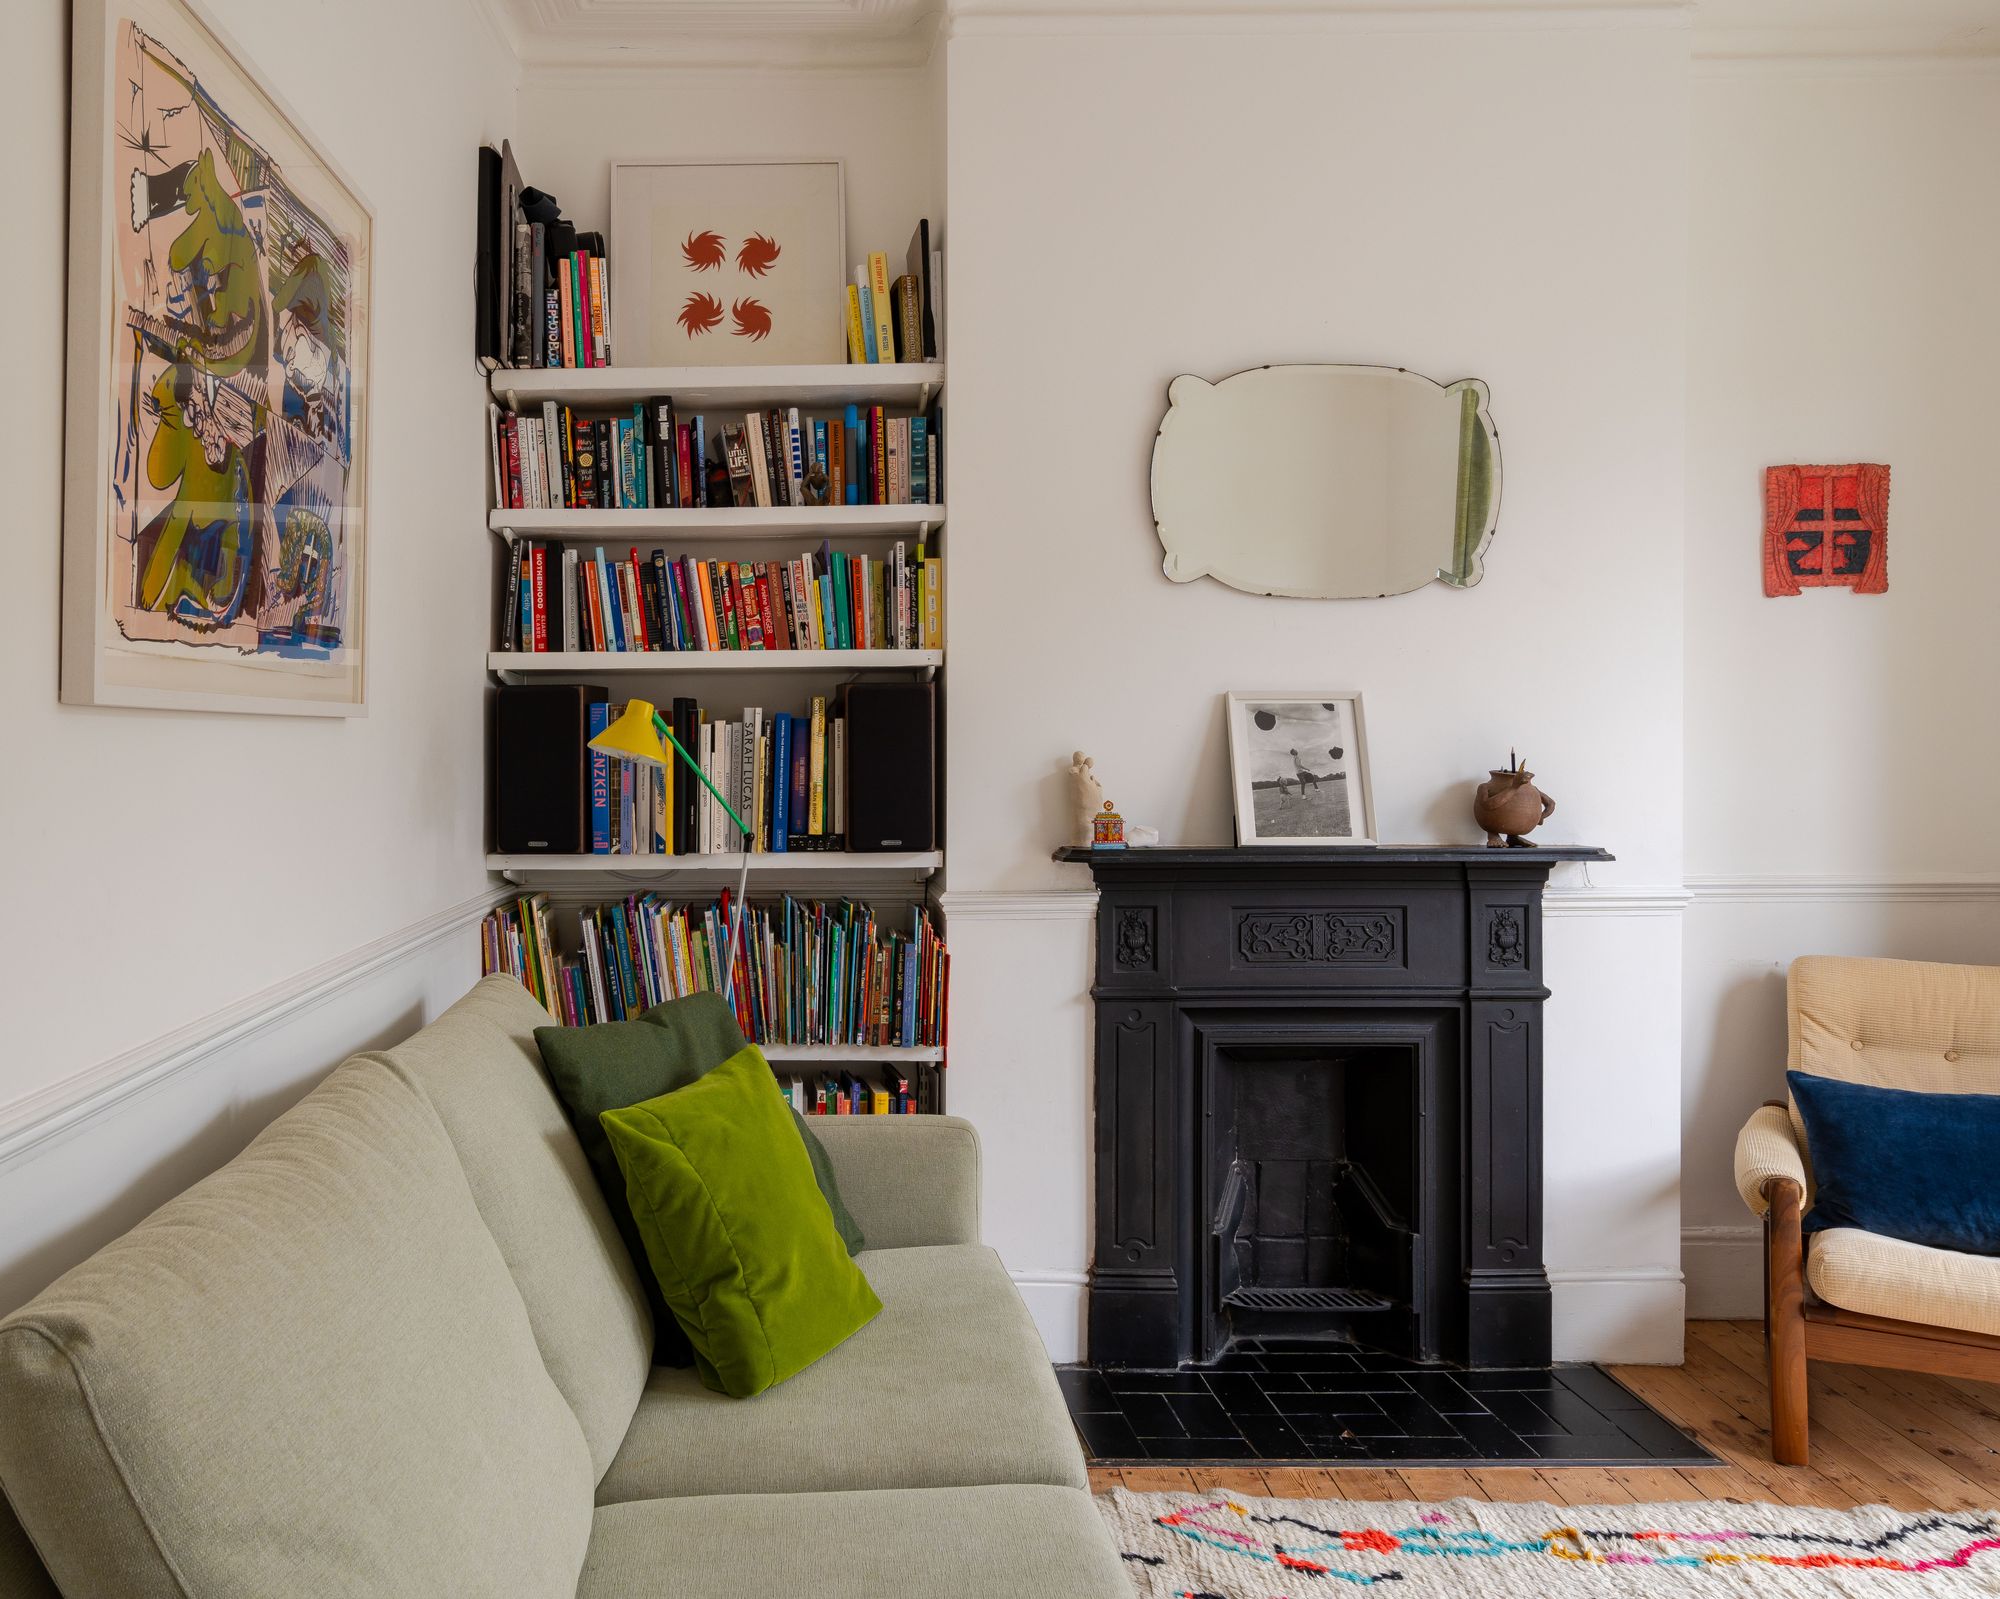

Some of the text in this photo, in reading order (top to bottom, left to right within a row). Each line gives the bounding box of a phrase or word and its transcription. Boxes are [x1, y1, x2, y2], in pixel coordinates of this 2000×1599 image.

[593, 305, 602, 334] FEMINIST
[658, 405, 668, 421] Young
[772, 415, 780, 438] SOLDIER
[762, 420, 773, 460] MAX PORTER
[774, 438, 782, 458] SAILOR
[816, 428, 825, 440] THE
[518, 419, 530, 502] GEORGE SAUNDERS
[728, 448, 747, 457] LITTLE
[730, 455, 749, 467] LIFE
[876, 415, 885, 497] MATERIAL GIRLS
[768, 467, 776, 479] SHY
[777, 461, 785, 481] CLAIRE
[889, 457, 897, 495] ERASURE
[536, 553, 544, 609] MOTHERHOOD
[676, 574, 684, 593] CELLIST
[720, 565, 731, 607] Percival Everett
[713, 586, 722, 613] PORTER
[742, 588, 751, 605] SKIPPY
[760, 584, 773, 634] Arsène WENGER
[718, 618, 726, 637] LANNY
[593, 750, 606, 808] ENZKEN
[743, 722, 754, 810] SARAH LUCAS
[657, 773, 666, 816] Photography
[617, 920, 625, 944] Questions
[624, 973, 635, 1003] Dinosaurs
[609, 966, 618, 996] RETURN
